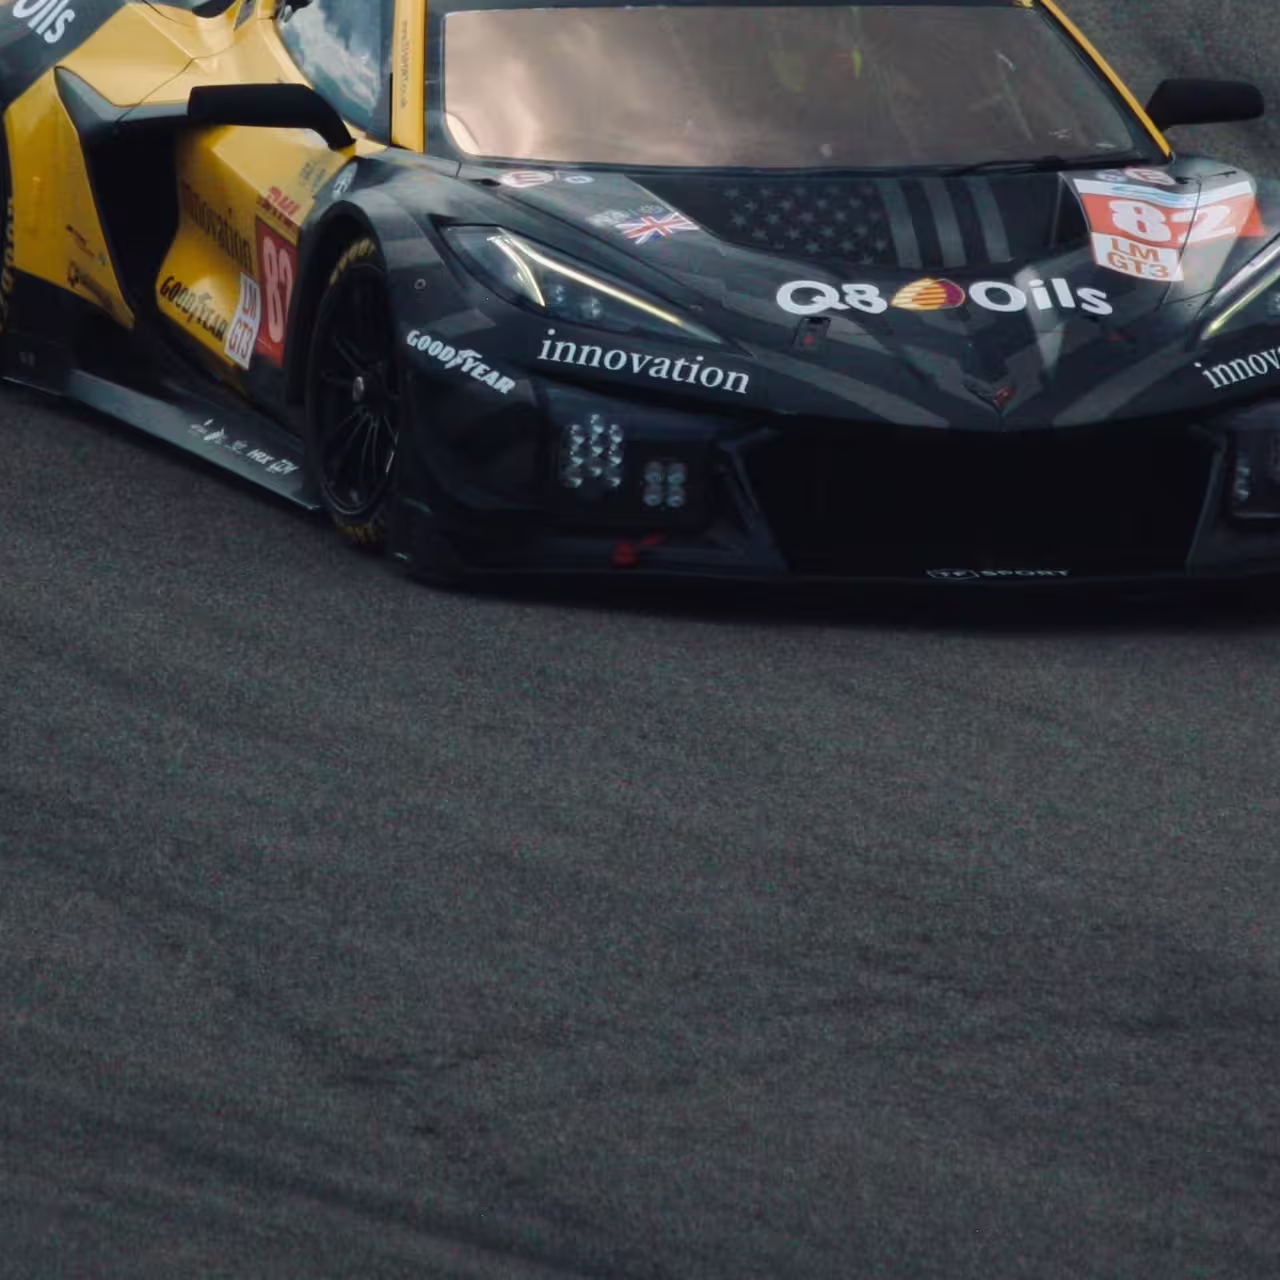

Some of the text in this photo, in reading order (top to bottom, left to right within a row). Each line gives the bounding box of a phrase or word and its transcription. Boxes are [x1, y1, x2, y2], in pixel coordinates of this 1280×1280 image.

[1108, 200, 1237, 243] 82
[1107, 252, 1169, 279] GT3
[1112, 237, 1160, 263] LM
[160, 276, 229, 342] GOODYEAR
[776, 278, 1113, 315] Q8 Oils
[228, 319, 255, 360] GT3
[406, 329, 516, 395] GOODYEAR
[538, 328, 750, 394] innovation
